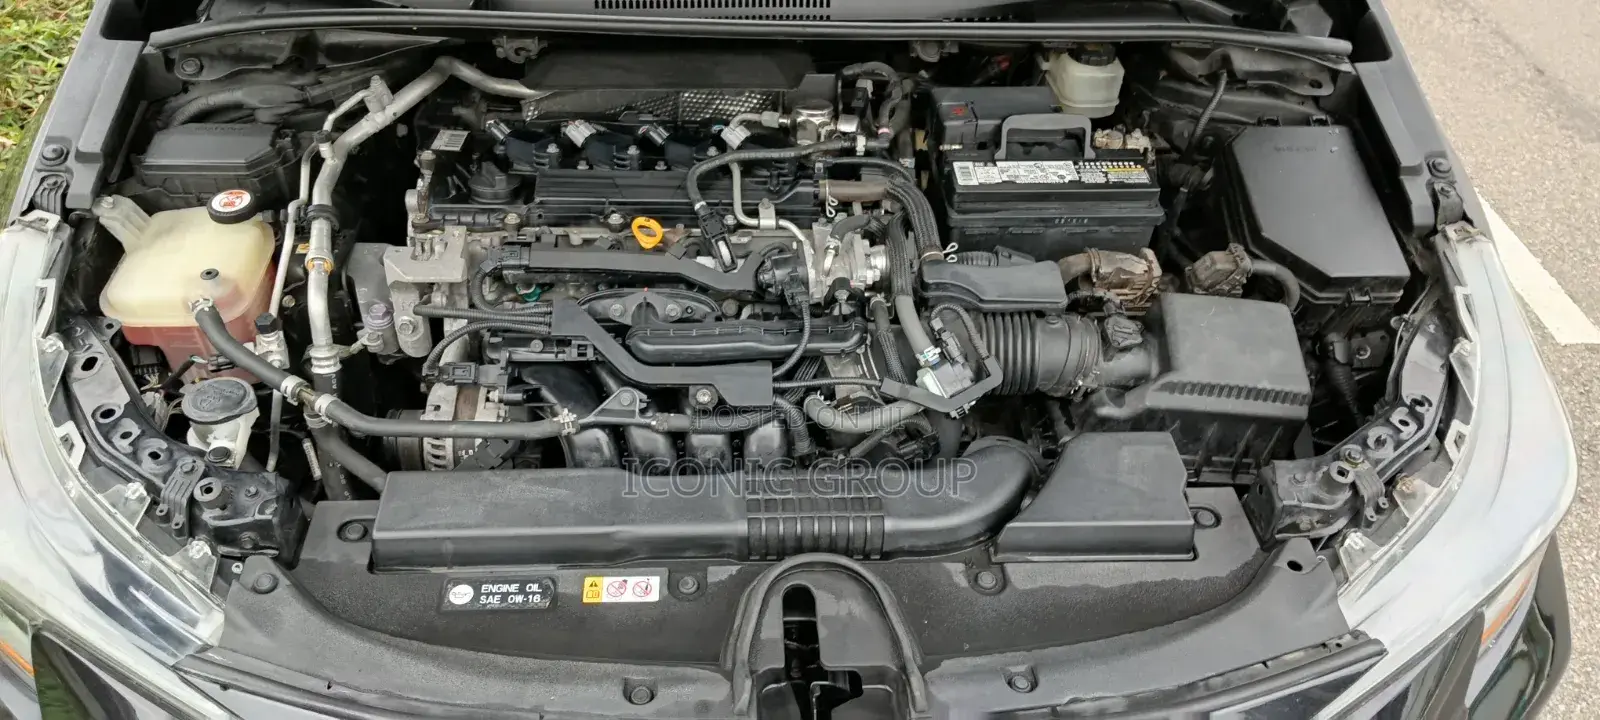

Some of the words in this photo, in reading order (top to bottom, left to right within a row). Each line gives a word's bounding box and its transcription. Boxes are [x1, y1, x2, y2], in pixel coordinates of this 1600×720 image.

[481, 584, 520, 593] ENGINE
[525, 583, 542, 592] OIL
[479, 595, 501, 604] SAE
